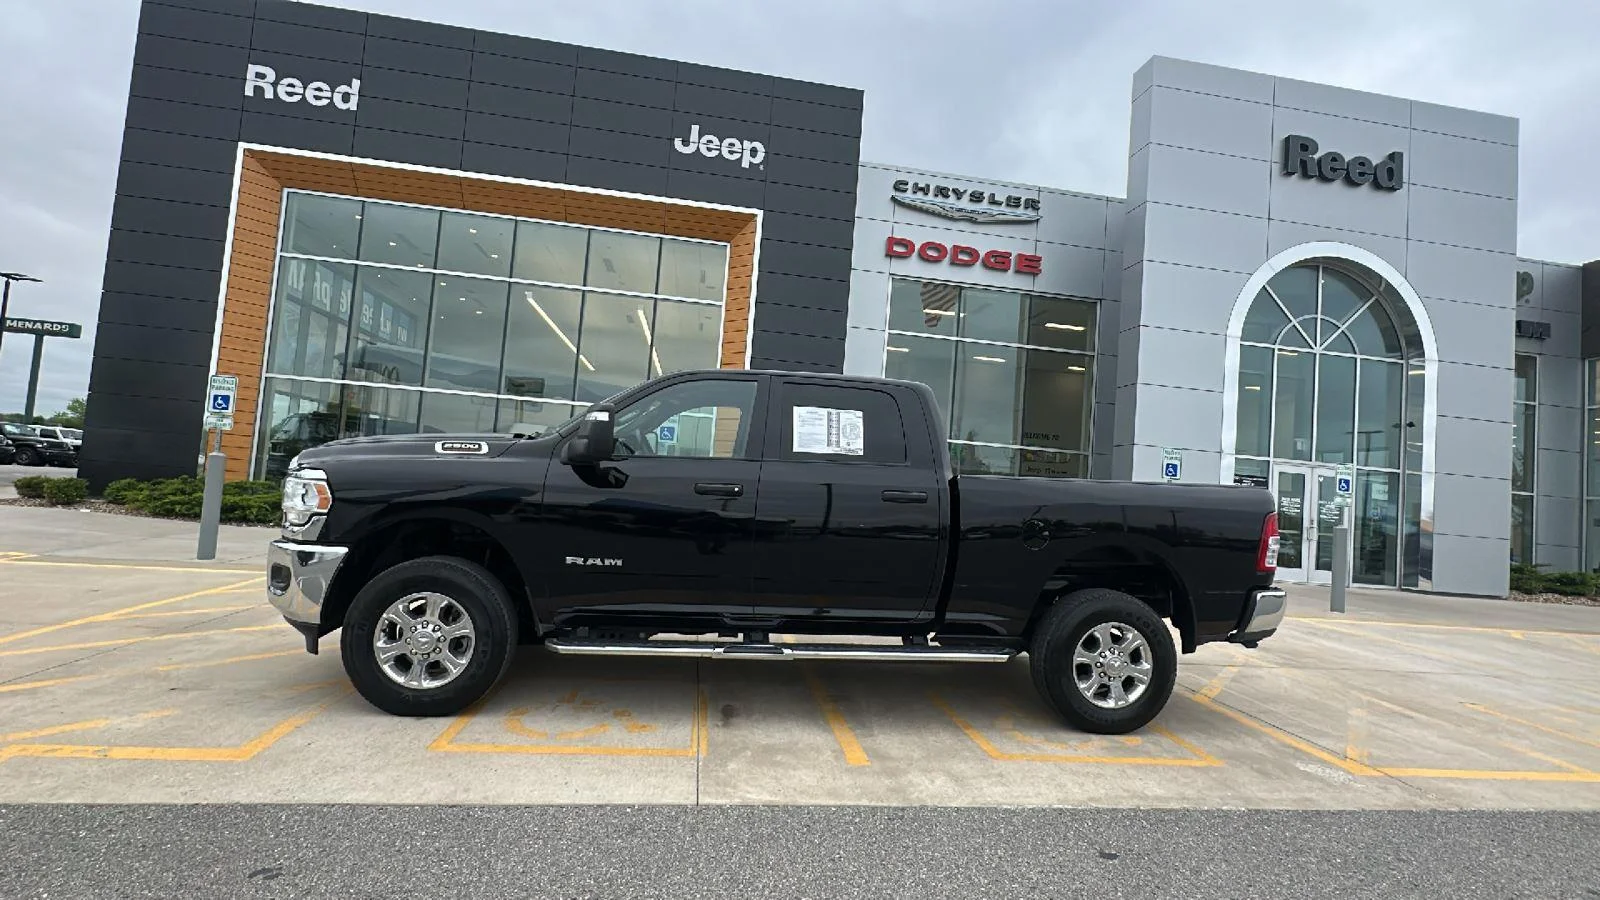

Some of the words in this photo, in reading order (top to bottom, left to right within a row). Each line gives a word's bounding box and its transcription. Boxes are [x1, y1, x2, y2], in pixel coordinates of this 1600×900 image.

[245, 64, 361, 111] Reed
[674, 125, 766, 169] Jeep
[1283, 134, 1404, 191] Reed
[893, 179, 1041, 211] CHRYSLER
[886, 236, 1043, 275] DODGE
[565, 556, 623, 567] RAM
